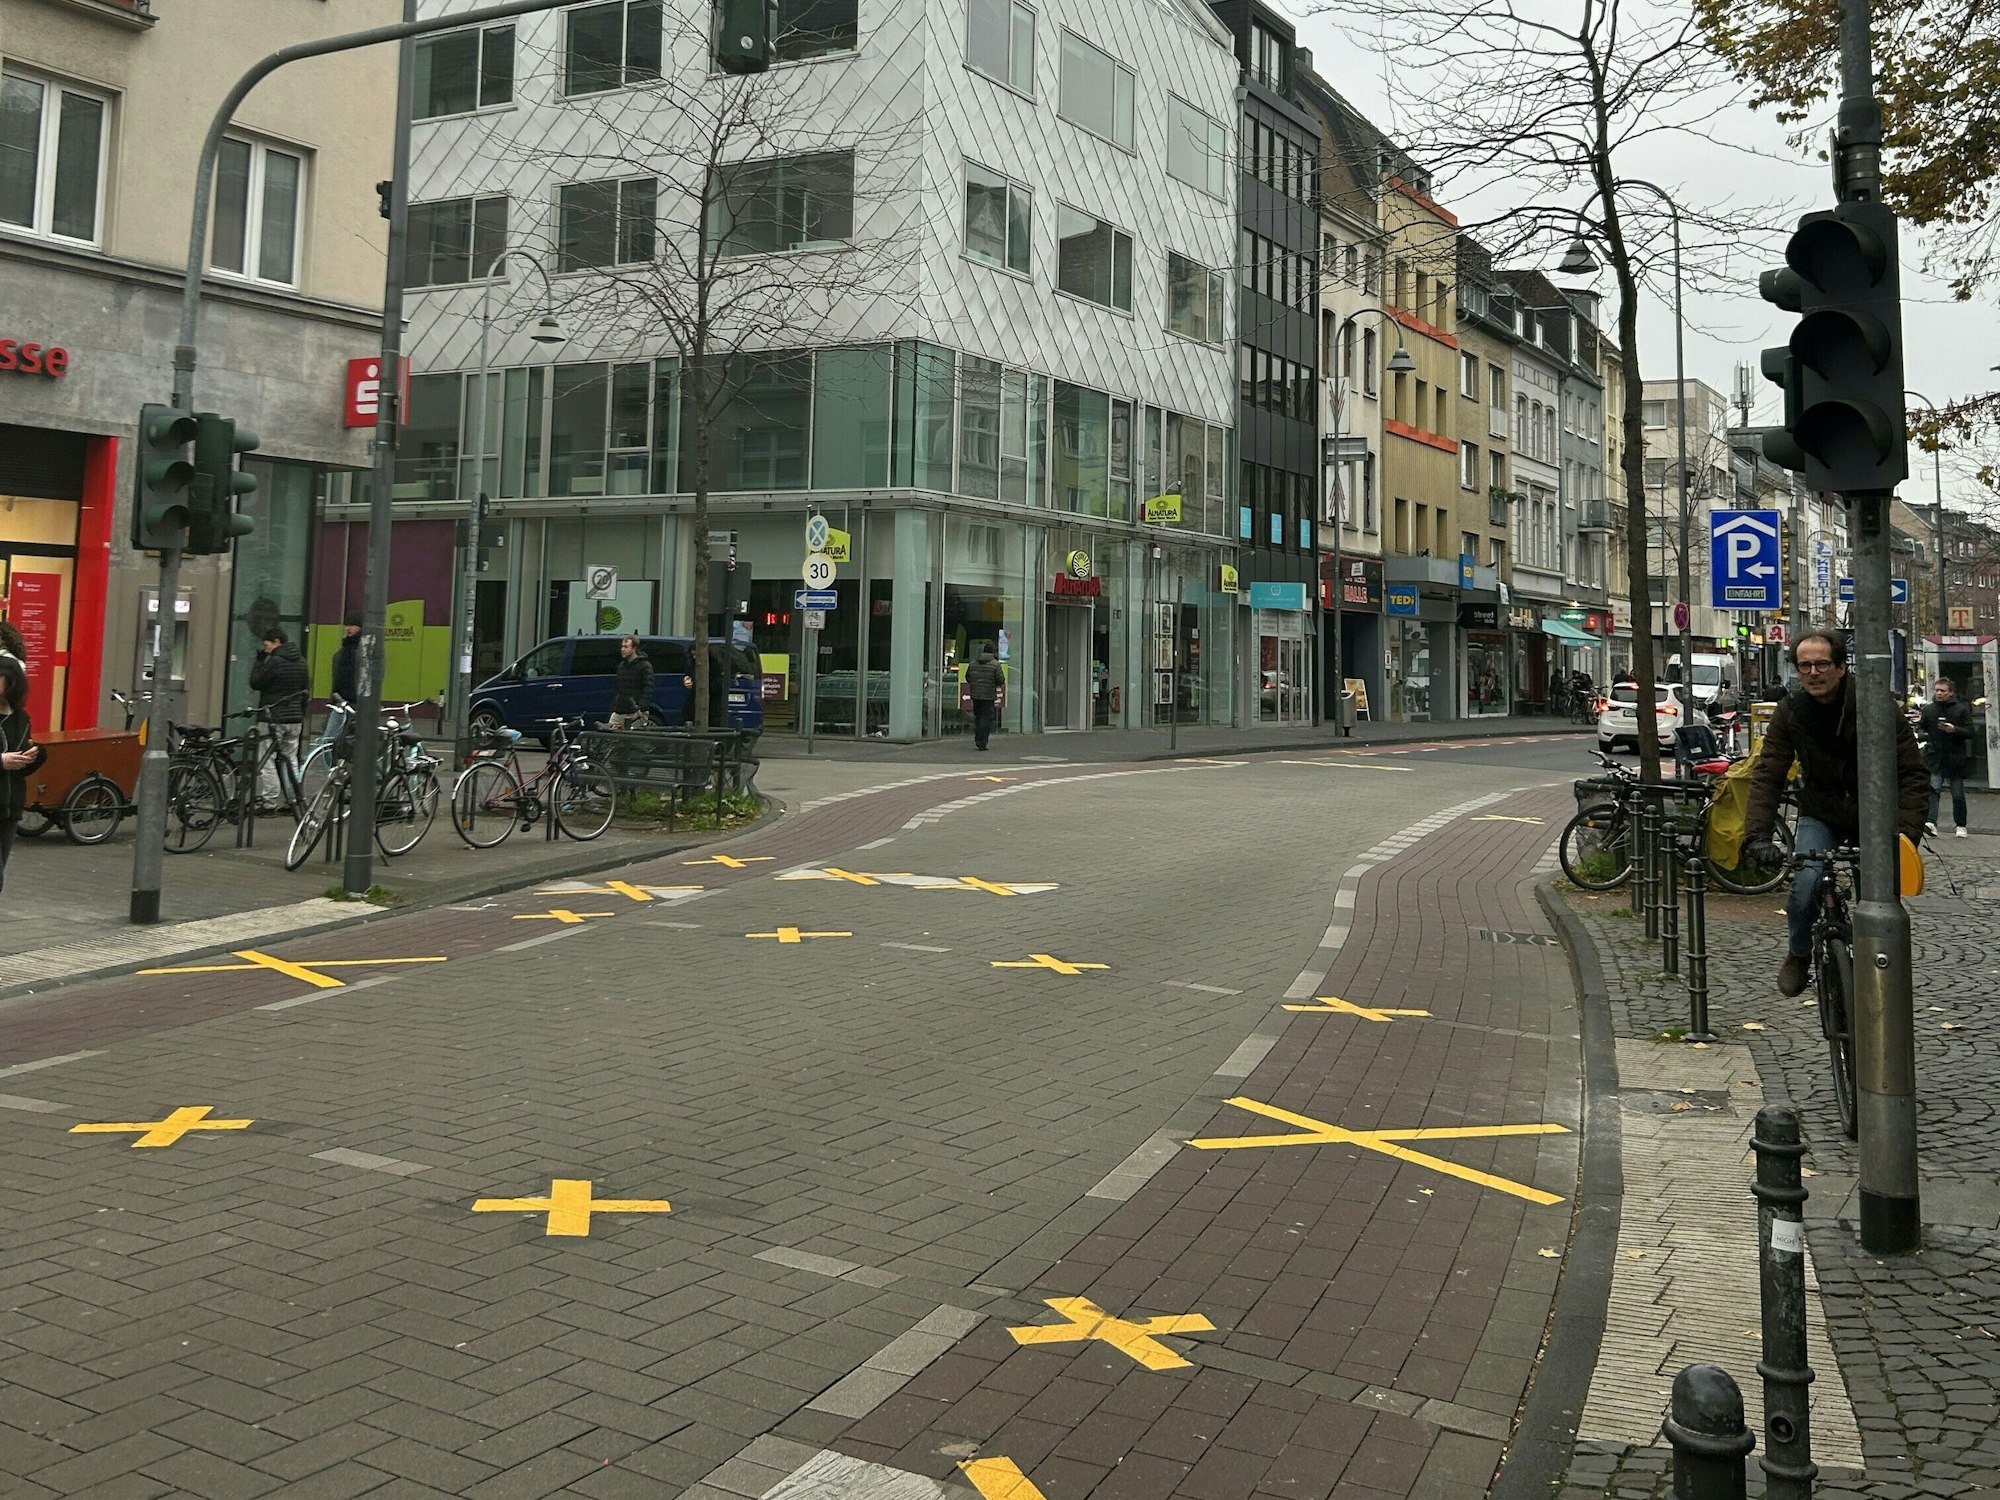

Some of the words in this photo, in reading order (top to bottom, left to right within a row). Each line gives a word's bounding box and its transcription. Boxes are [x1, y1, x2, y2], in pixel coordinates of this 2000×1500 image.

[1147, 508, 1178, 517] ALNATURA
[1727, 532, 1761, 579] P
[810, 563, 829, 579] 30
[597, 574, 609, 585] 20
[1344, 584, 1368, 604] HALLE
[1728, 589, 1765, 598] EINFAHRT
[1390, 595, 1415, 605] TEDi
[384, 625, 415, 638] LNATURA
